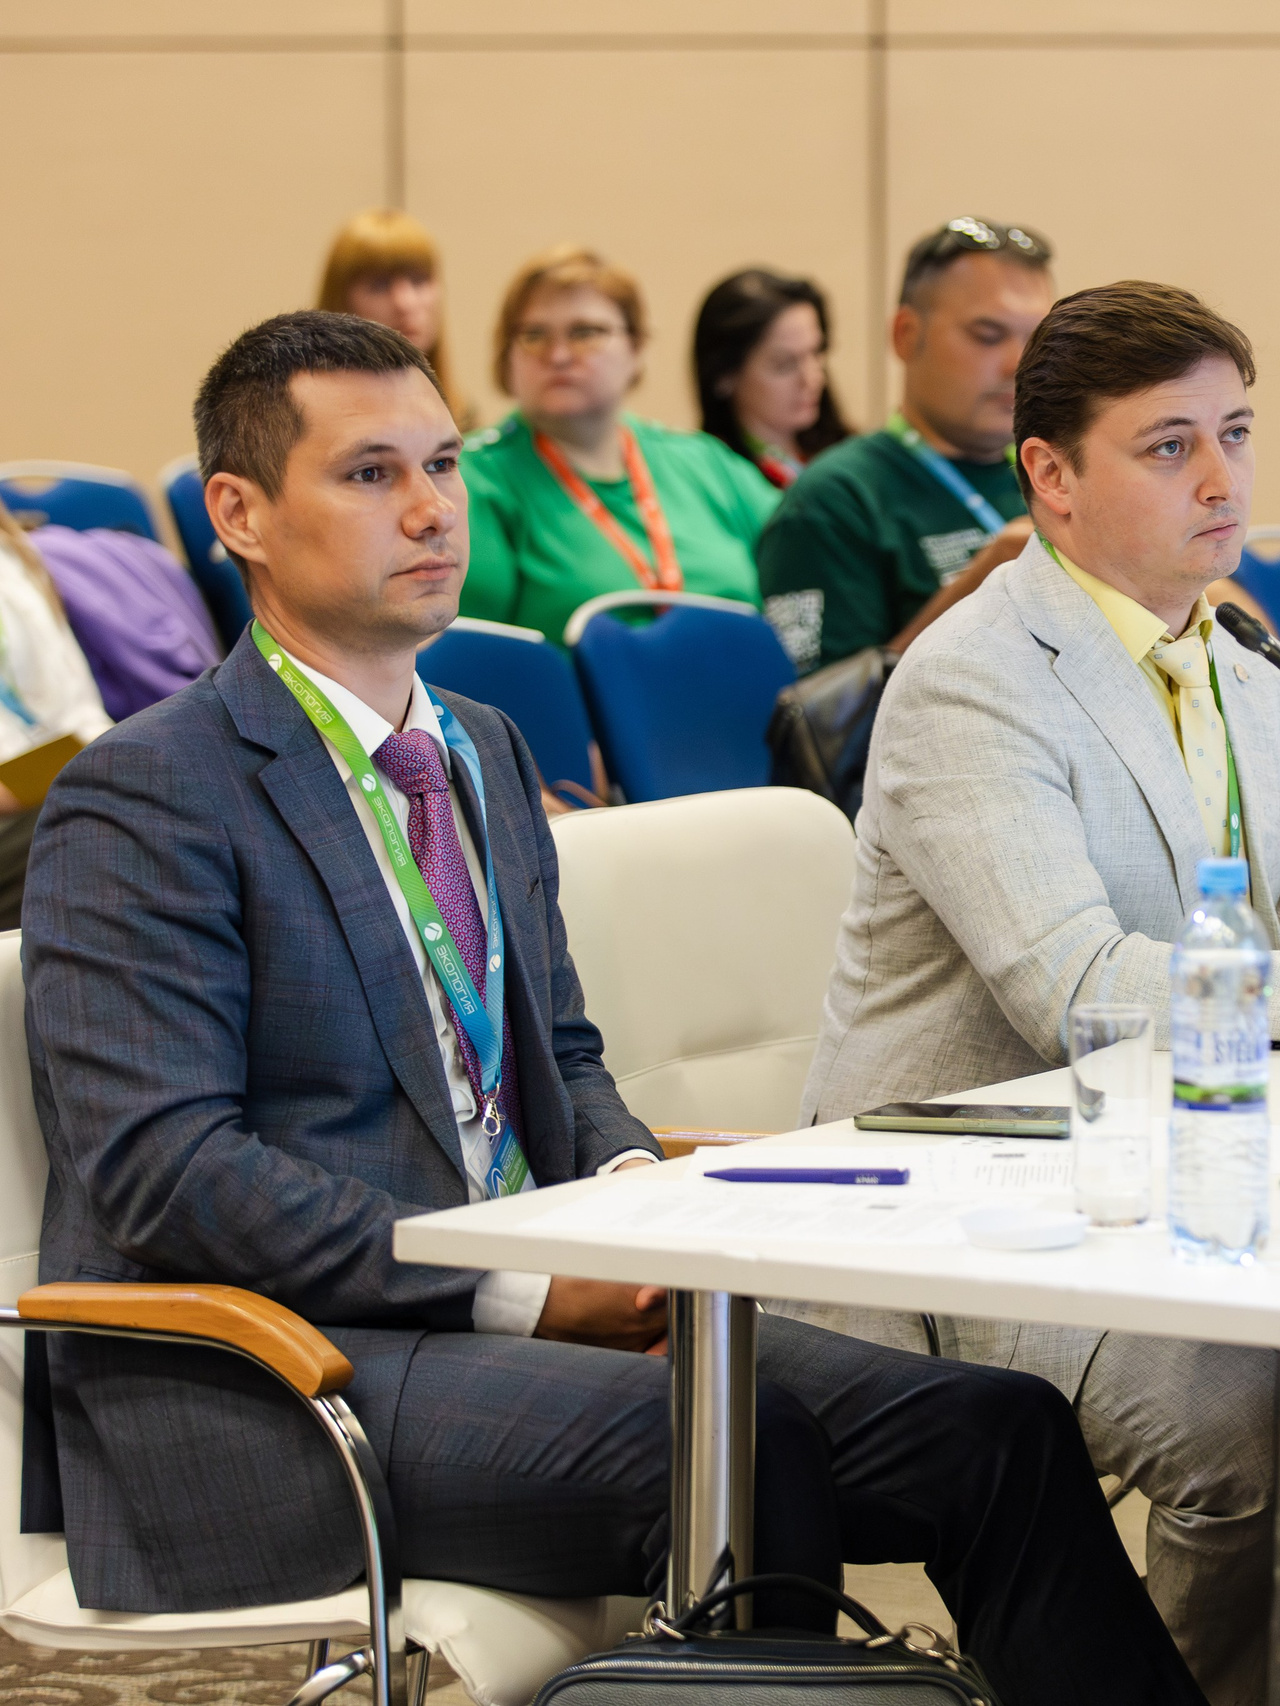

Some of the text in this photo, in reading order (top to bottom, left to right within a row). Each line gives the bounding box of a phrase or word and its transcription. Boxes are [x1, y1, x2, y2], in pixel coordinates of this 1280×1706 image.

[281, 670, 332, 725] ЭКОЛОГИЯ
[373, 795, 406, 867] ЭКОЛОГИЯ
[437, 945, 475, 1015] ЭКОЛОГИЯ
